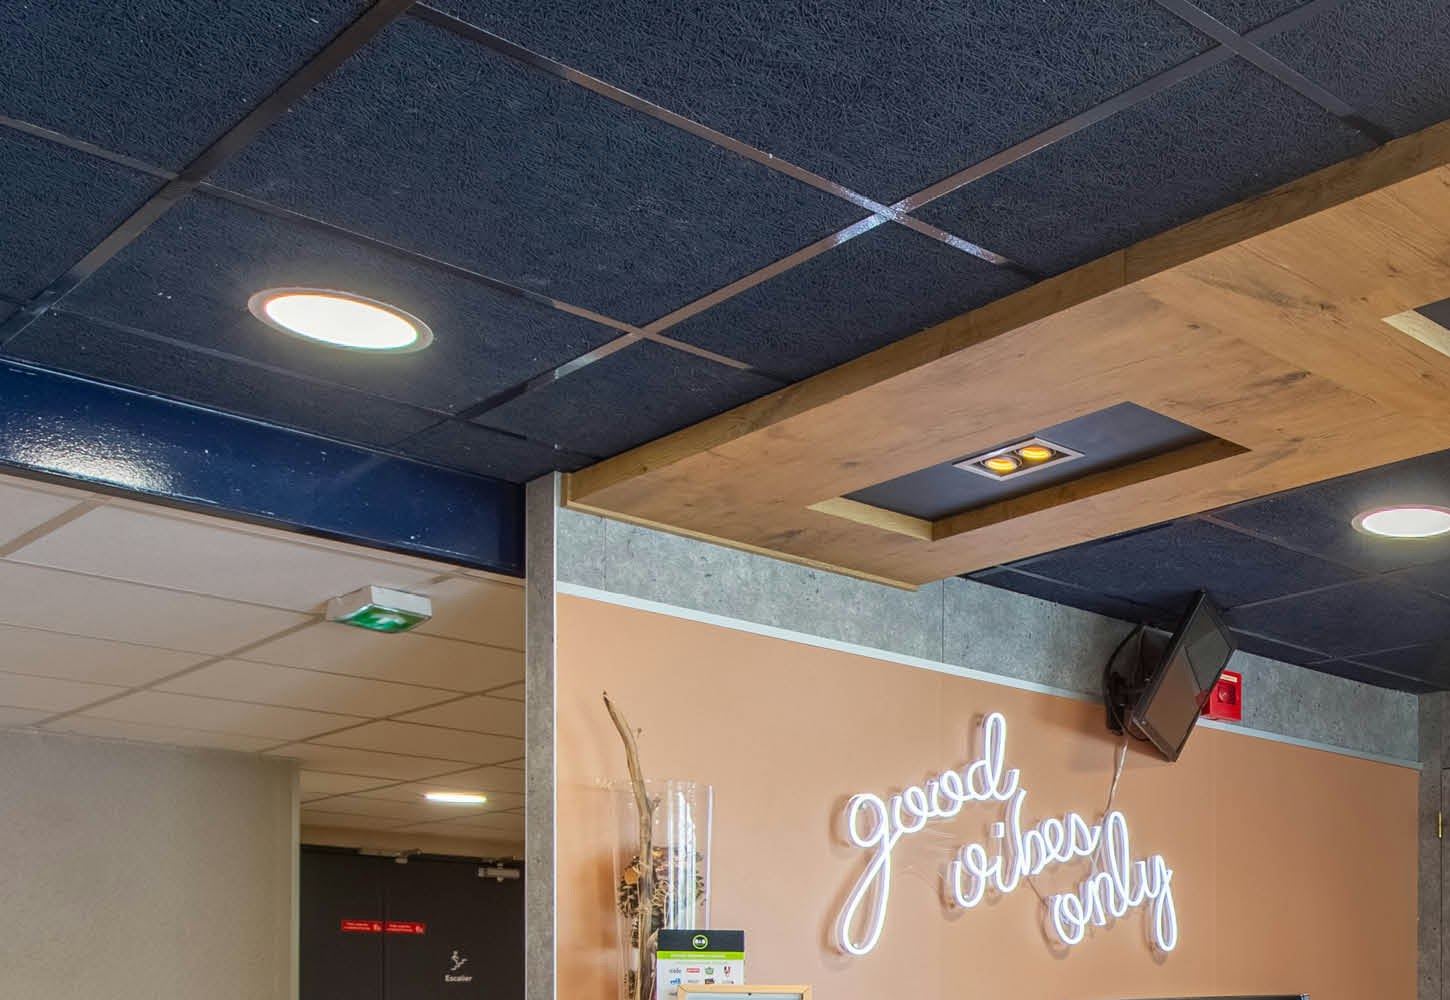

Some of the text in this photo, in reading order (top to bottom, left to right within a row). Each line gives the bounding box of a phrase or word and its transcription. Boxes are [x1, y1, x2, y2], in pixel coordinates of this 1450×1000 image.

[840, 711, 1021, 956] good
[950, 788, 1102, 909] vibes
[1051, 811, 1178, 952] only
[444, 974, 473, 982] Escalier
